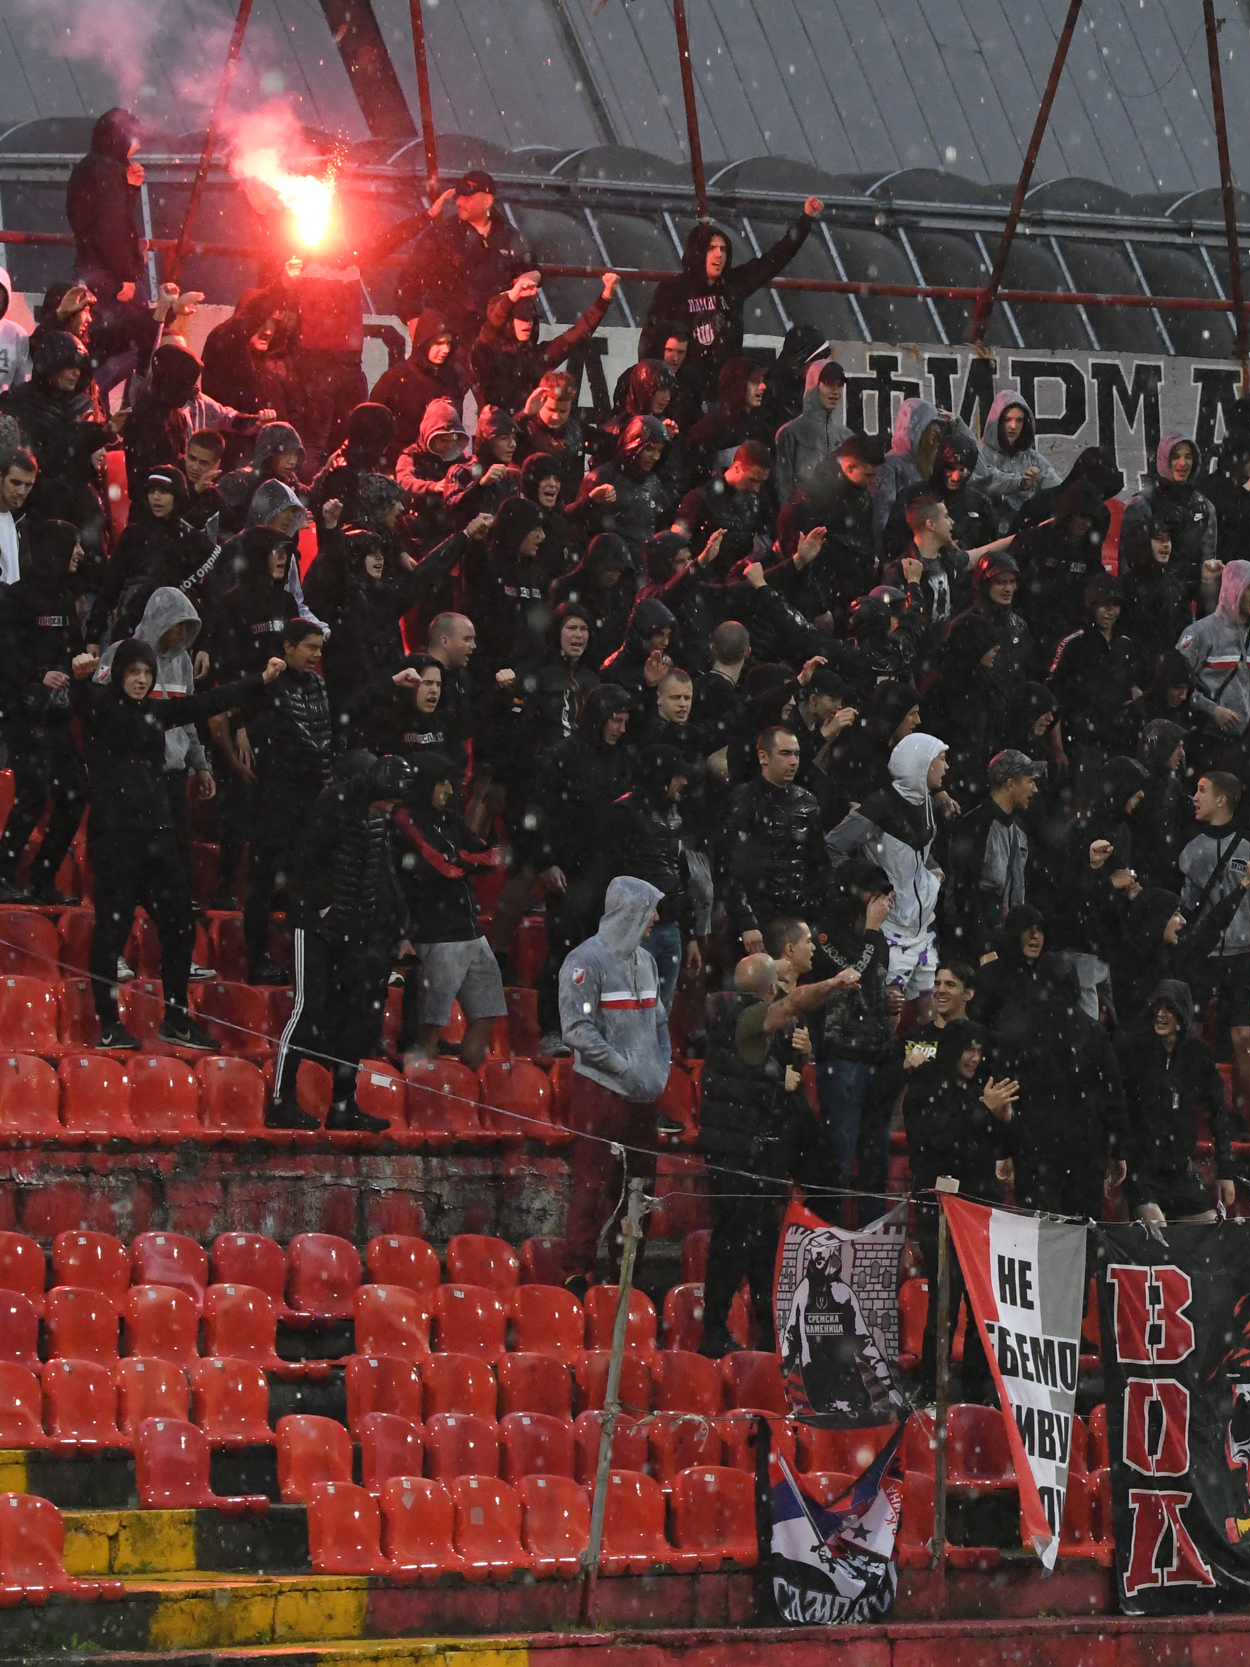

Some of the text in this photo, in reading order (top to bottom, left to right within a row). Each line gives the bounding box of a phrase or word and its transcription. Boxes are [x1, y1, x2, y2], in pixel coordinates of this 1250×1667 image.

[997, 1254, 1035, 1311] НЕ
[805, 1324, 844, 1333] КАМЕНИЦА
[807, 1315, 839, 1323] СРЕМСКА
[1010, 1403, 1070, 1464] ИВУ
